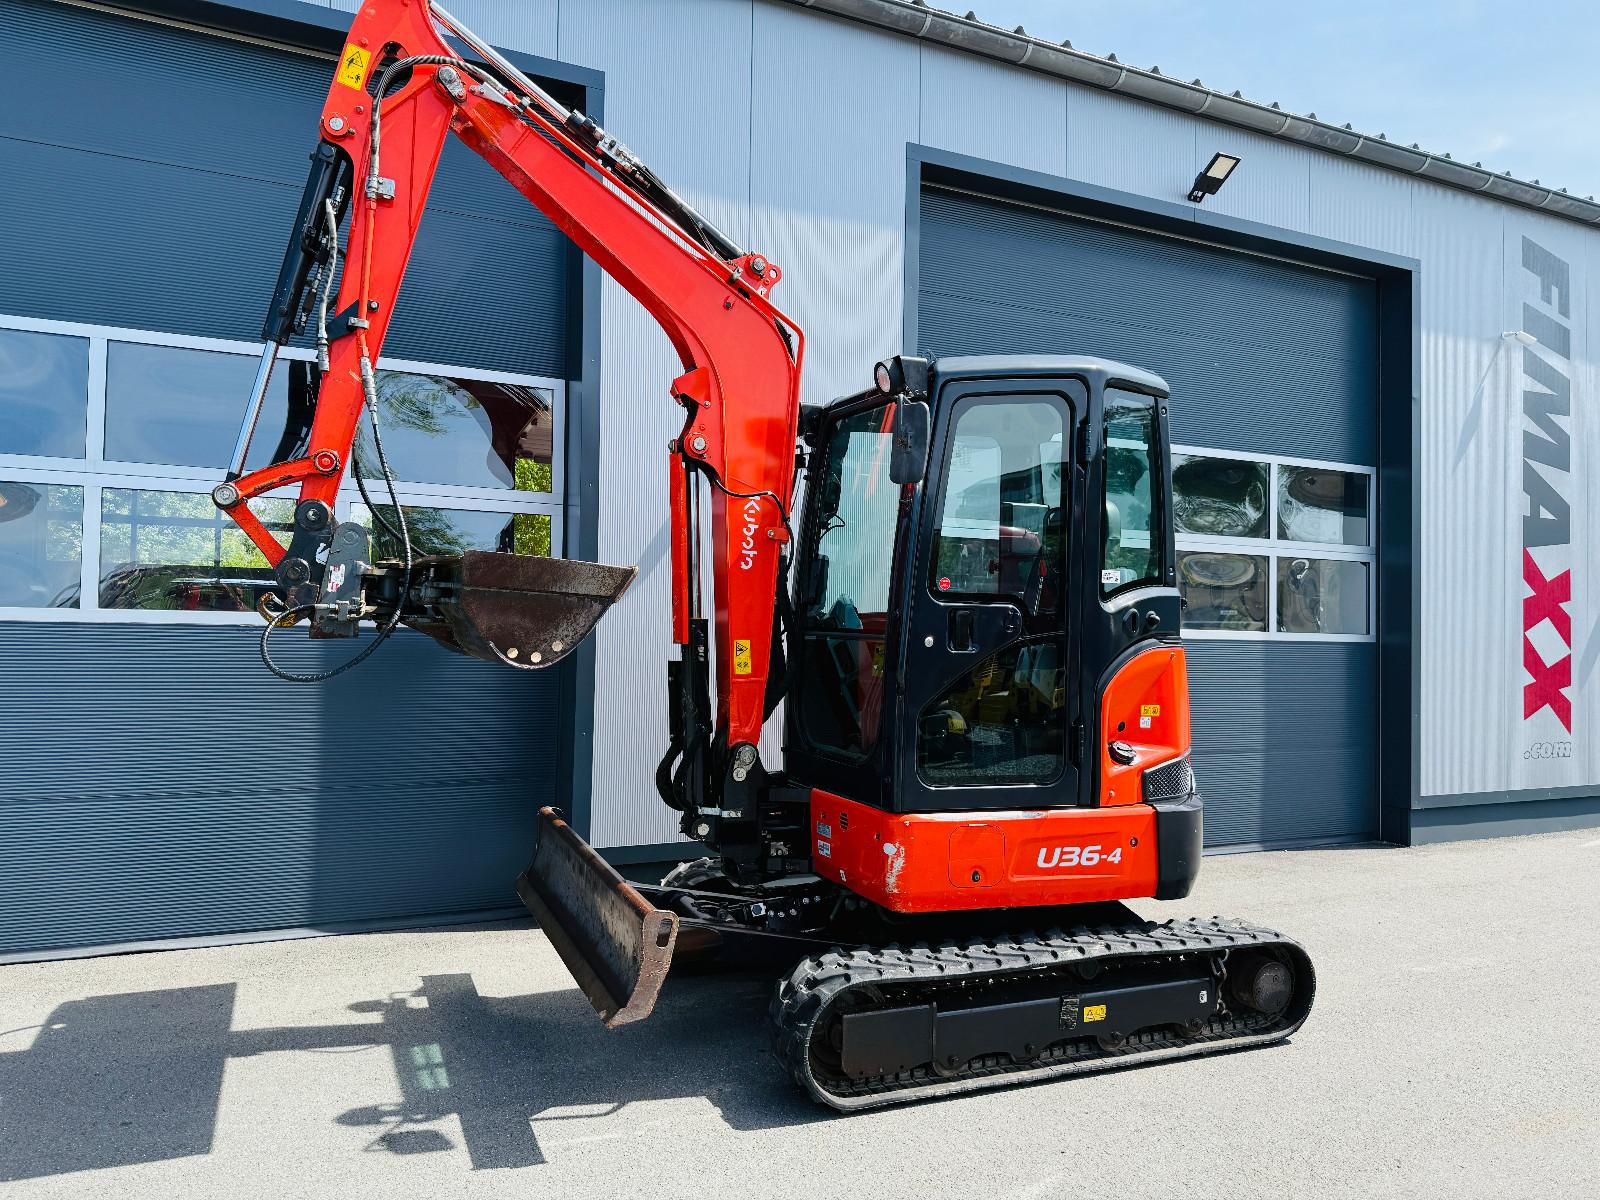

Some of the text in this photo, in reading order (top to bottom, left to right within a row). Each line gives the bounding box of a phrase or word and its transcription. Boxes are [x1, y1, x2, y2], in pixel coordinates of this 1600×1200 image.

[1521, 235, 1572, 735] FIMAXX
[740, 496, 761, 570] Kubota
[1523, 741, 1572, 760] .com
[1036, 845, 1122, 868] U36-4
